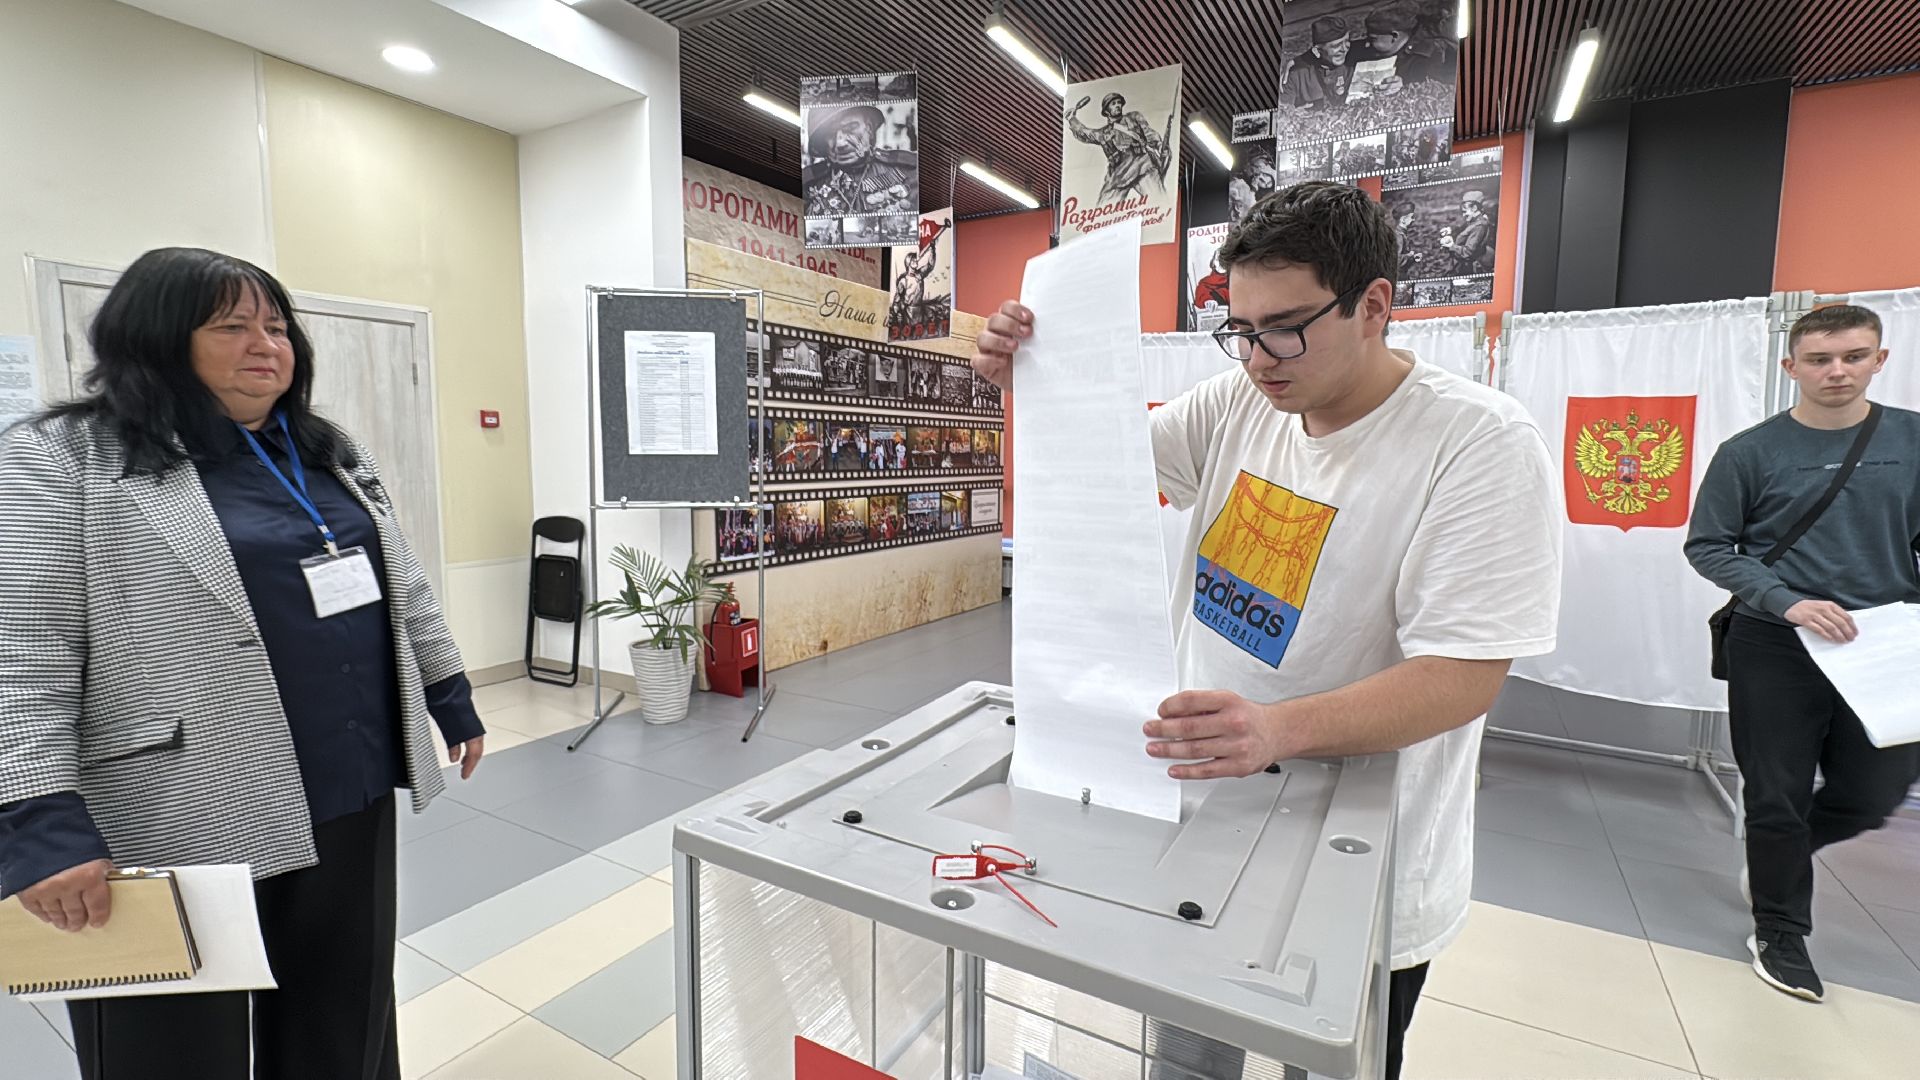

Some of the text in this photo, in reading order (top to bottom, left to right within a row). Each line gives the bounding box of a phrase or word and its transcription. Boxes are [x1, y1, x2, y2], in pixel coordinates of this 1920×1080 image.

[1062, 194, 1149, 229] Разгромим
[738, 235, 837, 278] 1941-1945
[819, 290, 877, 326] Наша
[1194, 599, 1261, 652] BASKETBALL
[1195, 571, 1285, 638] adidas
